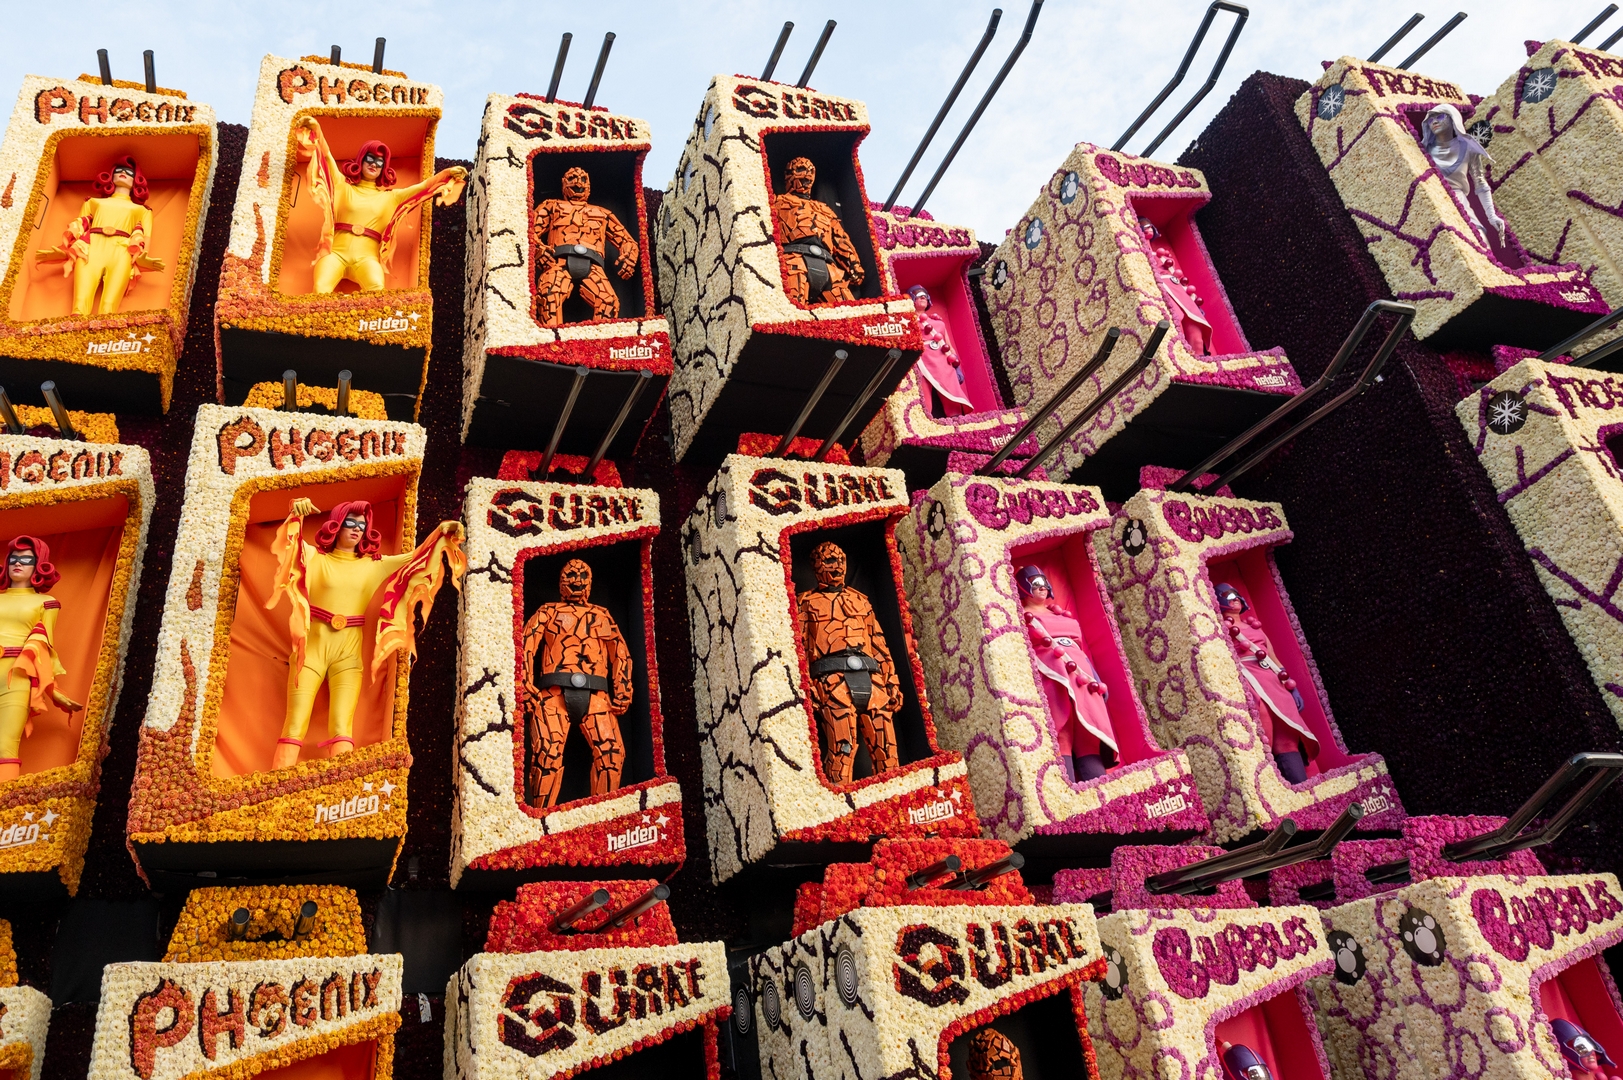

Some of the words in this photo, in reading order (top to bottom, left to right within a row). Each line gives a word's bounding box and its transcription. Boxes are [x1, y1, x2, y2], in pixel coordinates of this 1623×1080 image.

[276, 65, 429, 104] PHOENIX
[34, 86, 197, 125] PHOENIX
[732, 84, 858, 121] QUAKE
[503, 103, 638, 141] QUAKE
[358, 317, 409, 334] helden
[864, 322, 904, 338] helden
[86, 339, 142, 355] helden
[610, 345, 654, 361] helden
[216, 415, 406, 475] PHOENIX
[748, 467, 895, 515] QUAKE
[486, 487, 642, 538] QUAKE
[314, 793, 380, 825] helden
[908, 798, 954, 825] helden
[1143, 792, 1188, 819] helden
[1361, 795, 1389, 816] elden
[0, 823, 40, 849] den
[606, 824, 659, 852] helden
[893, 916, 1085, 1007] QUAKE
[128, 967, 383, 1080] PHOENIX
[498, 956, 705, 1058] QUAKE
